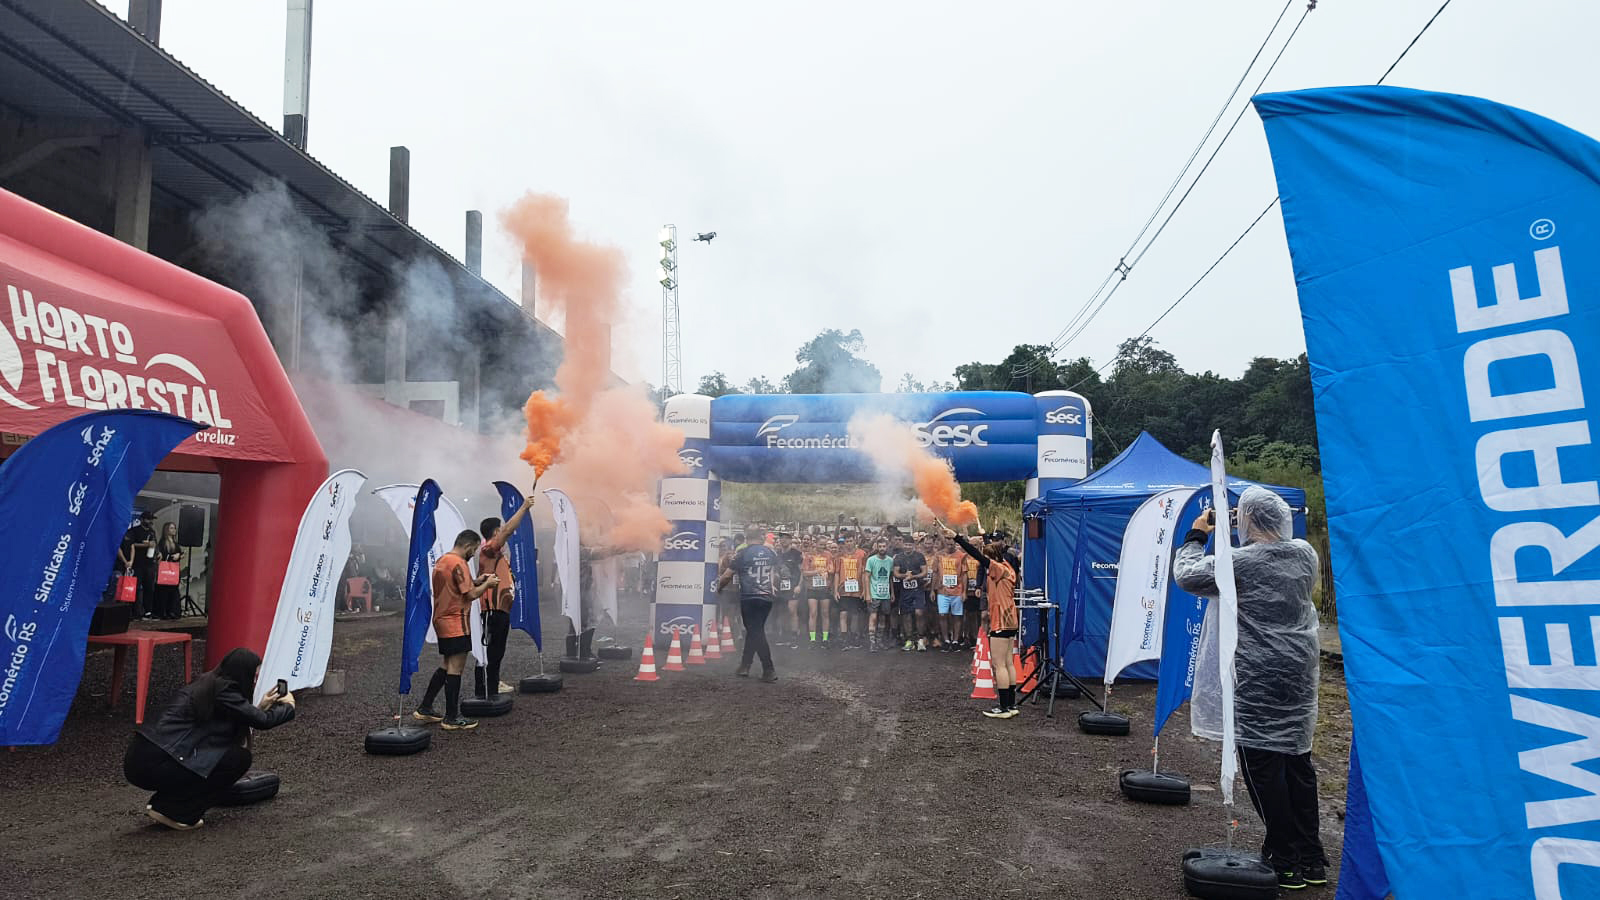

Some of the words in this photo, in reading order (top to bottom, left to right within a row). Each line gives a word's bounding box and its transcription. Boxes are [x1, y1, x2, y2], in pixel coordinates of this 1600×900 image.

[8, 284, 138, 365] HORTO
[35, 349, 233, 429] FLORESTAL
[195, 429, 236, 446] creluz
[680, 456, 703, 467] esc
[0, 644, 28, 716] comércio
[18, 622, 37, 641] RS
[34, 534, 71, 602] Sindicatos
[69, 482, 88, 516] Sesc
[87, 425, 116, 467] Senac
[1449, 246, 1600, 900] WERADE
[291, 625, 309, 677] Fecomércio
[303, 610, 313, 623] RS
[309, 553, 325, 598] Sindicatos
[1140, 610, 1153, 650] Fecomércio
[1147, 599, 1155, 609] RS
[1191, 622, 1201, 635] RS
[1184, 635, 1199, 688] Fecomércio
